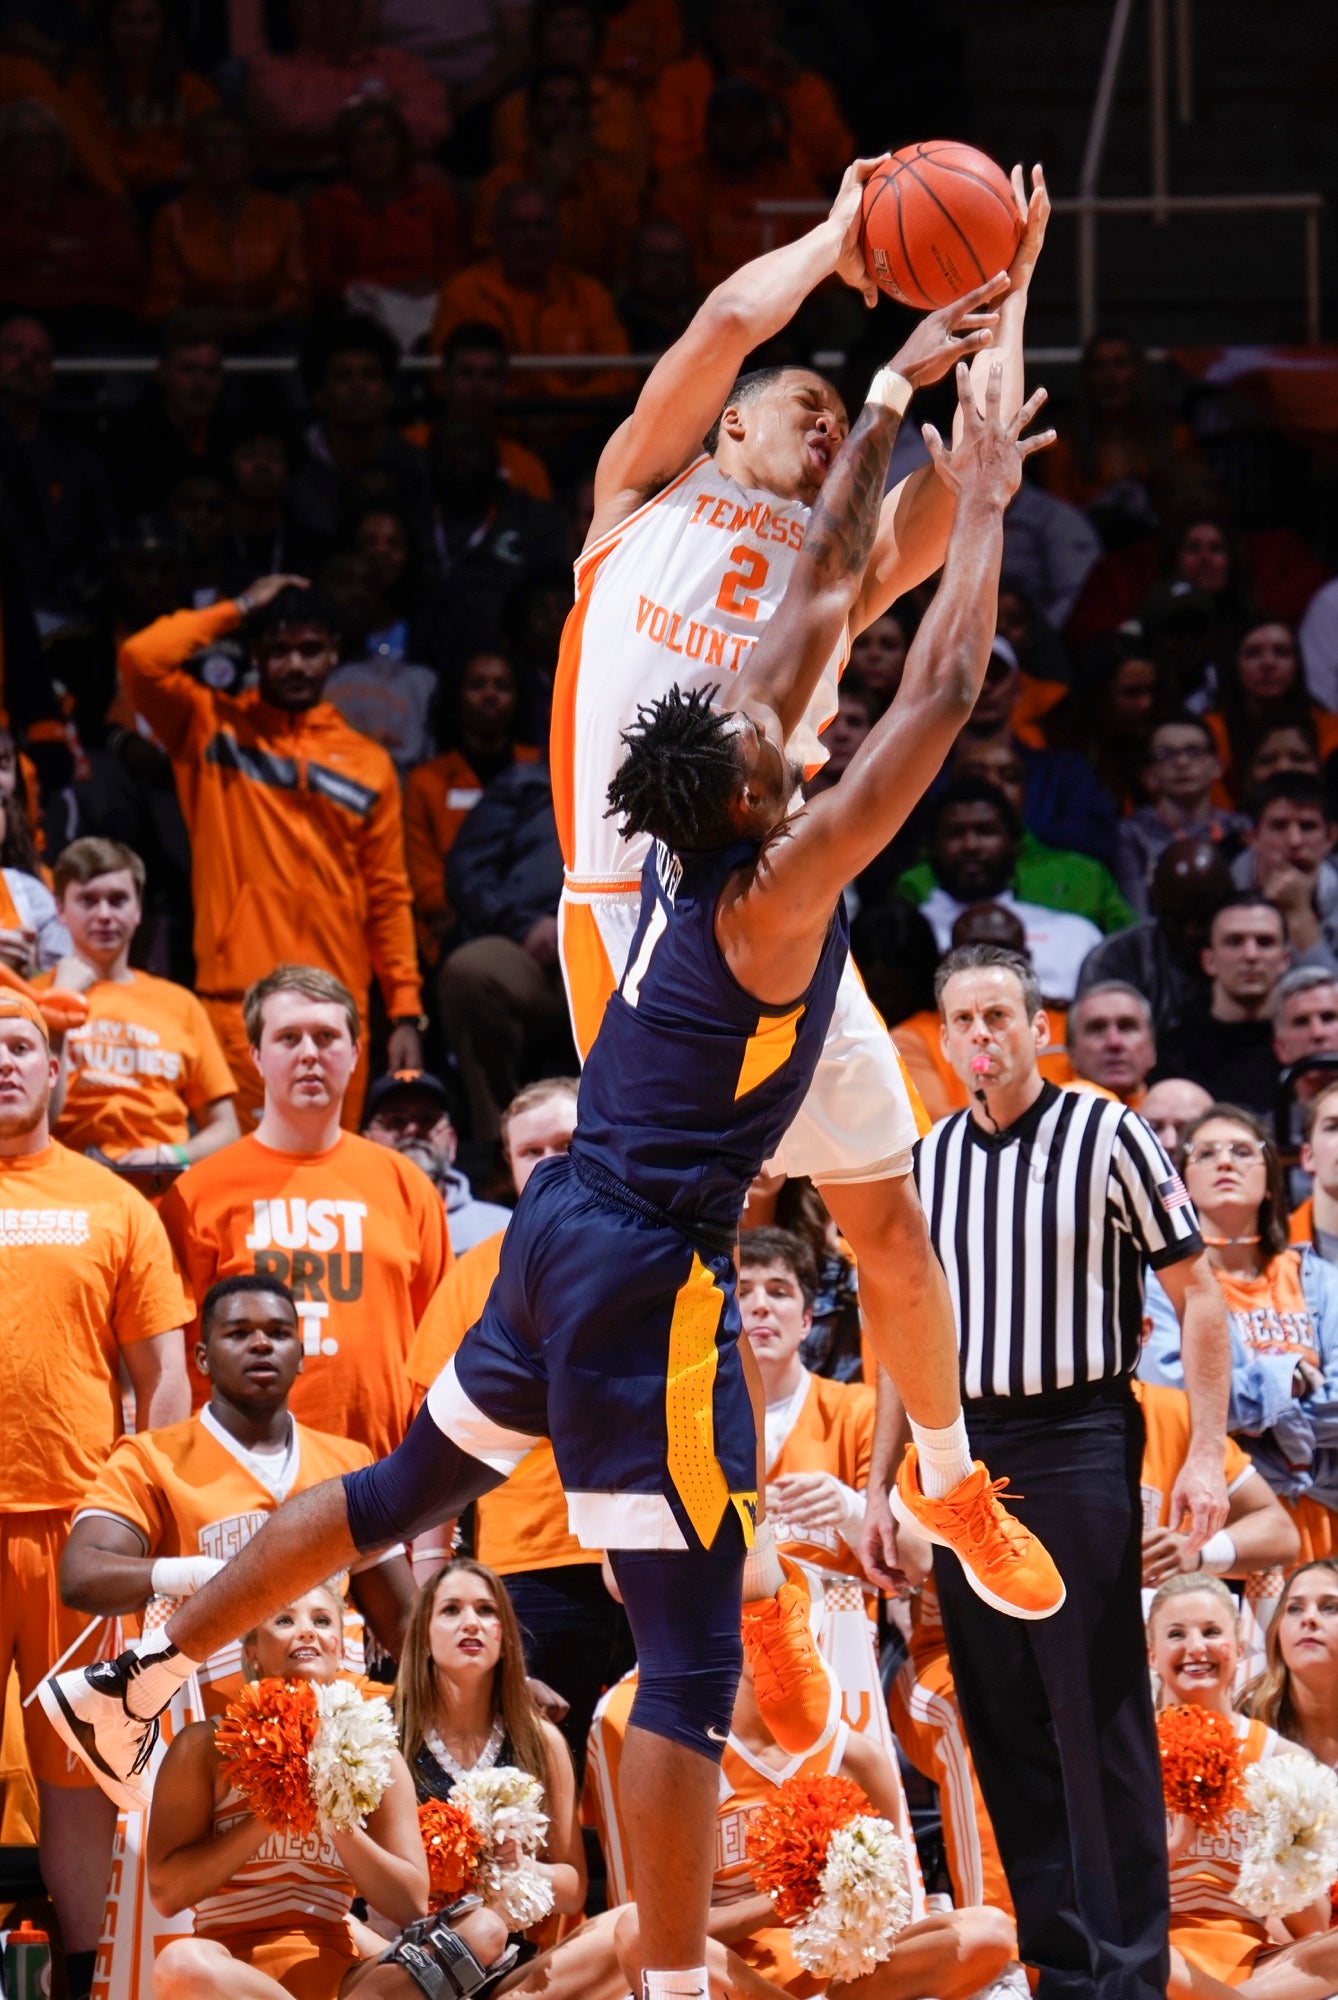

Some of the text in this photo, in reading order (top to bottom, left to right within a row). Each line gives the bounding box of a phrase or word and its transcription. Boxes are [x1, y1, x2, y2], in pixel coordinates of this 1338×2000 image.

[715, 544, 769, 622] 2
[635, 594, 758, 673] VOLUNT
[622, 897, 668, 1008] 1
[0, 1208, 89, 1231] ESSEE
[246, 1198, 369, 1252] JUST
[294, 1301, 339, 1356] T.
